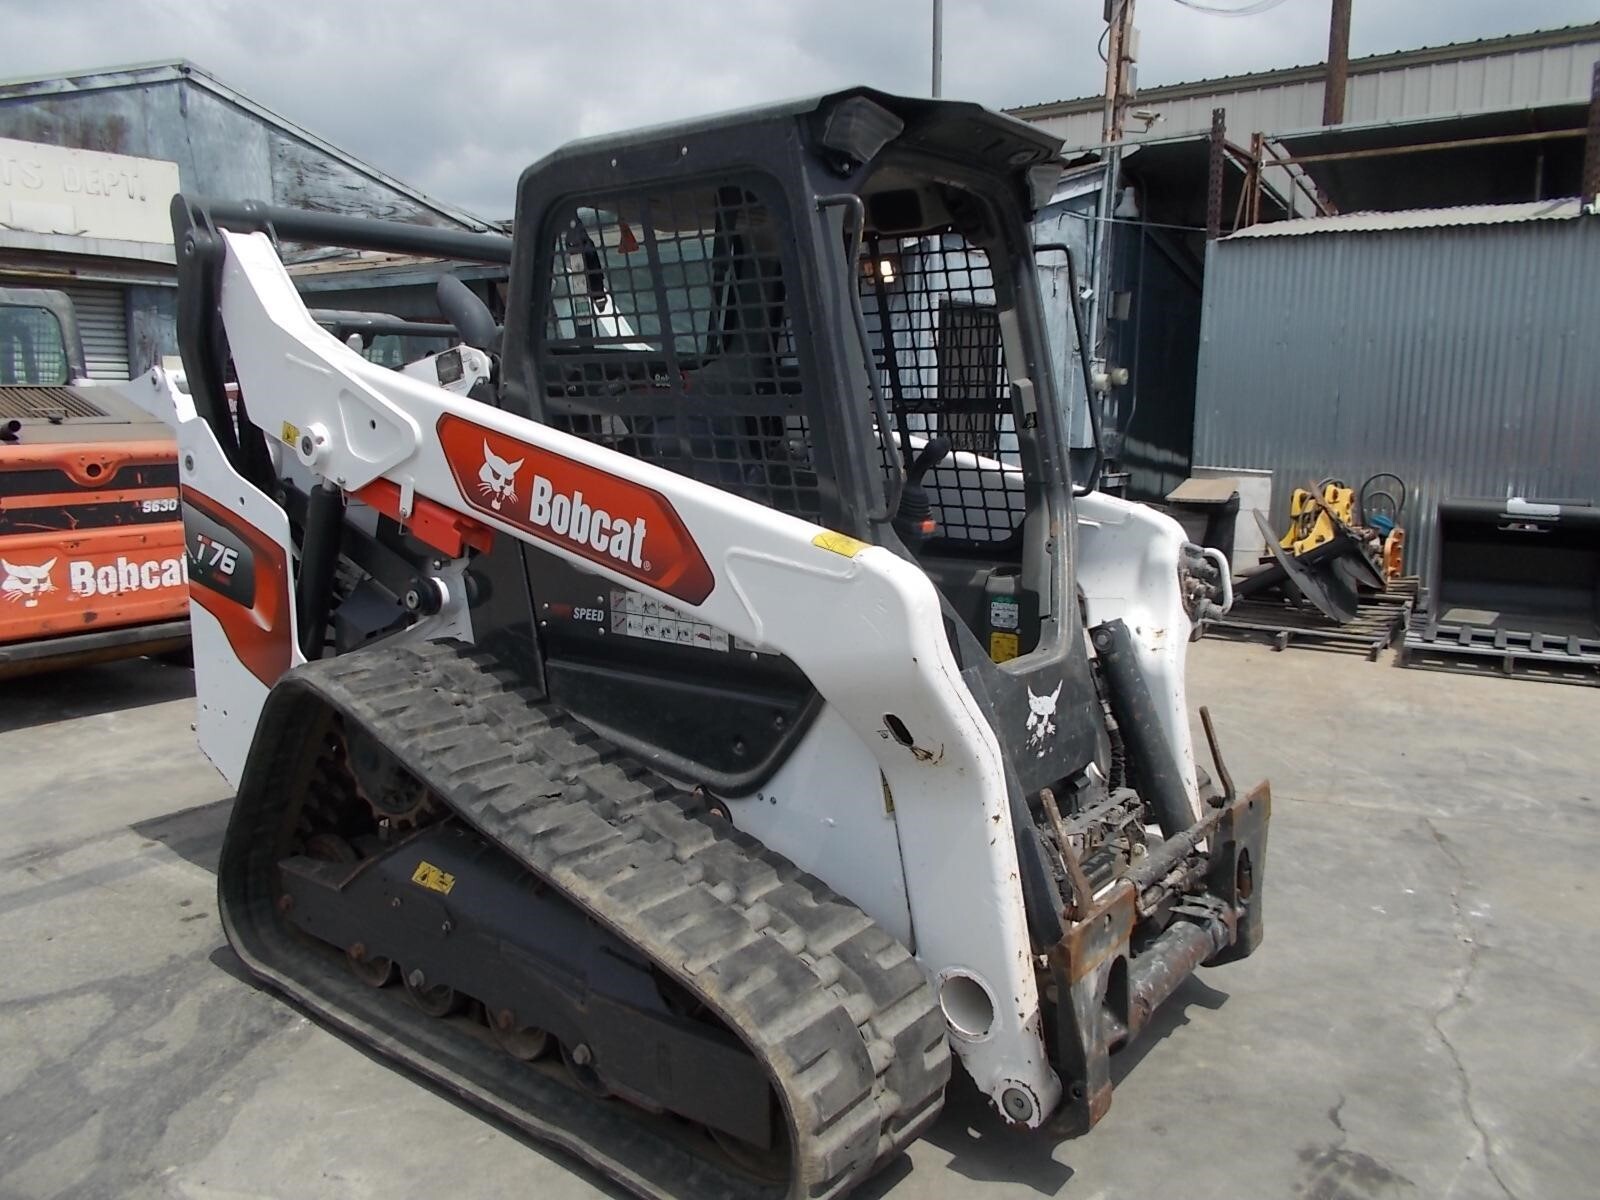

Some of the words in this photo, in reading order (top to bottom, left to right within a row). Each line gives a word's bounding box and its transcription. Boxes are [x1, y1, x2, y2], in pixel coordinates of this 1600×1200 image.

[62, 163, 147, 203] DEPT.
[142, 499, 178, 513] S630
[530, 475, 647, 569] Bobcat
[197, 534, 239, 575] T76
[70, 552, 189, 598] Bobcat
[573, 607, 604, 622] SPEED
